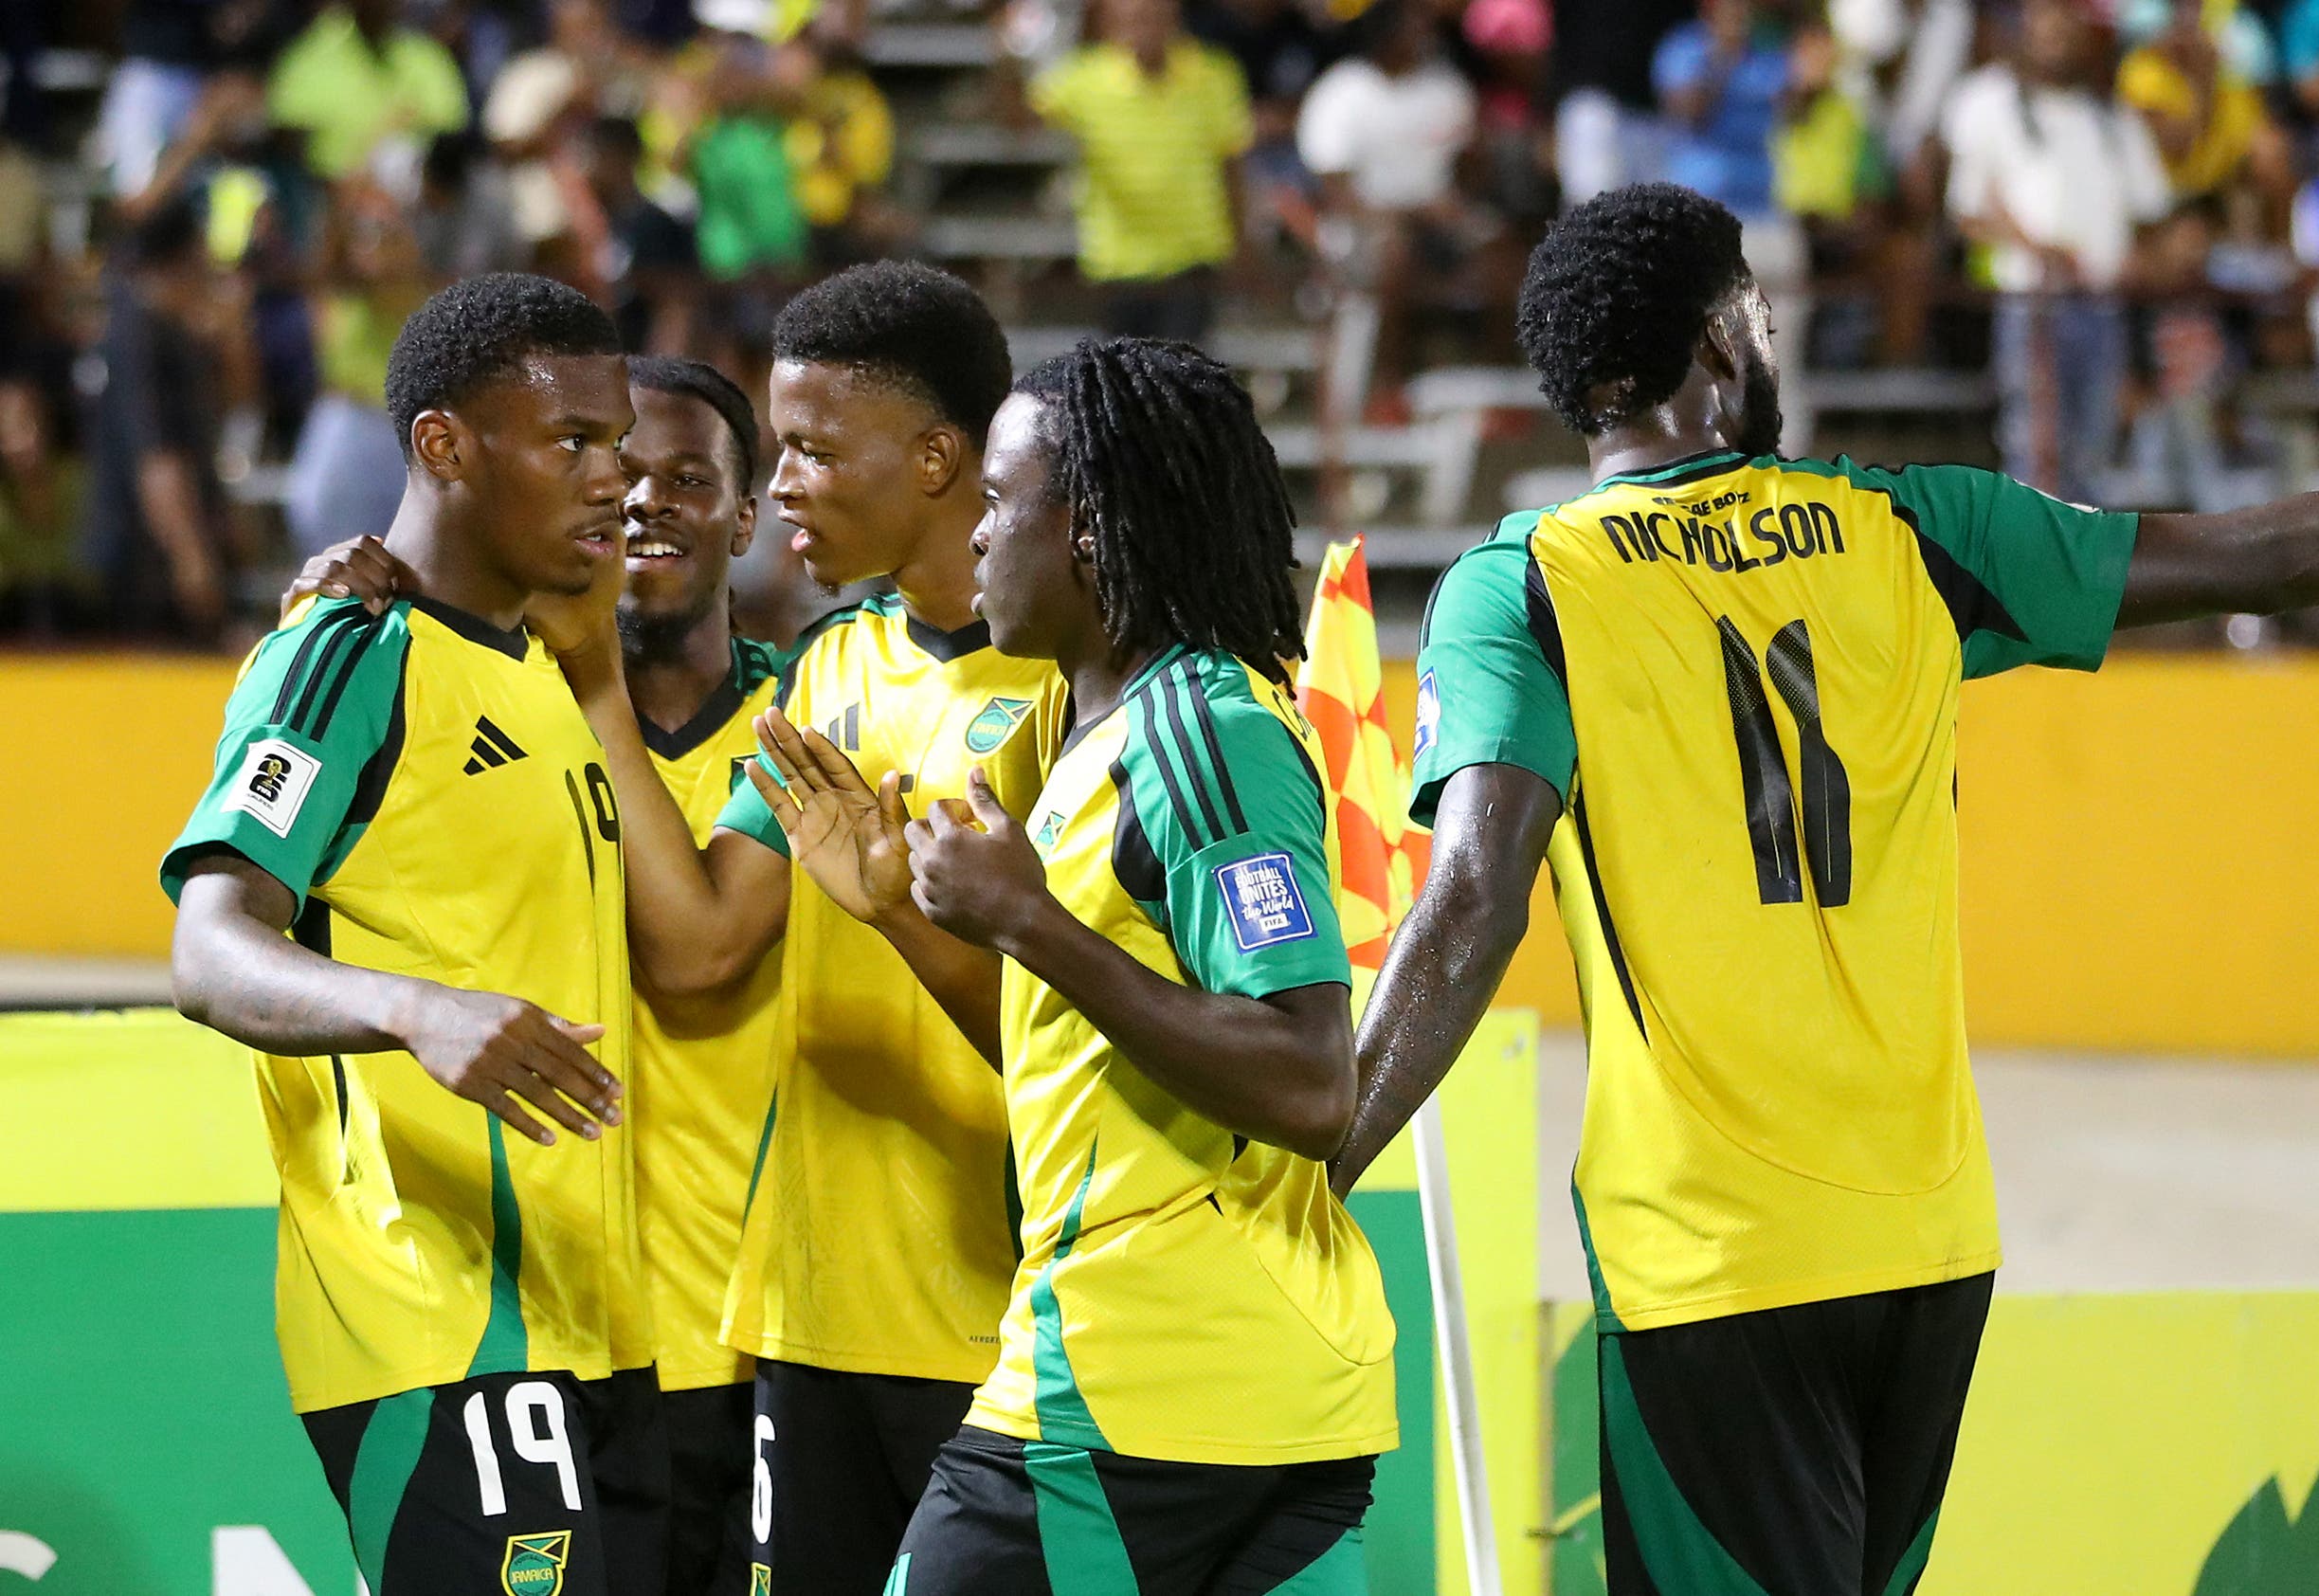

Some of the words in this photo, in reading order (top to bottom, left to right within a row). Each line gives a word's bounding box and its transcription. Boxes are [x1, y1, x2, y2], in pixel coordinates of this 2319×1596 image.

[1600, 501, 1845, 573] NICHOLSON
[1716, 614, 1853, 908] 11
[1239, 879, 1288, 904] UNITES
[1260, 895, 1295, 916] World
[1264, 917, 1284, 928] FIFA
[463, 1381, 583, 1516] 19
[510, 1567, 554, 1585] JAMAICA
